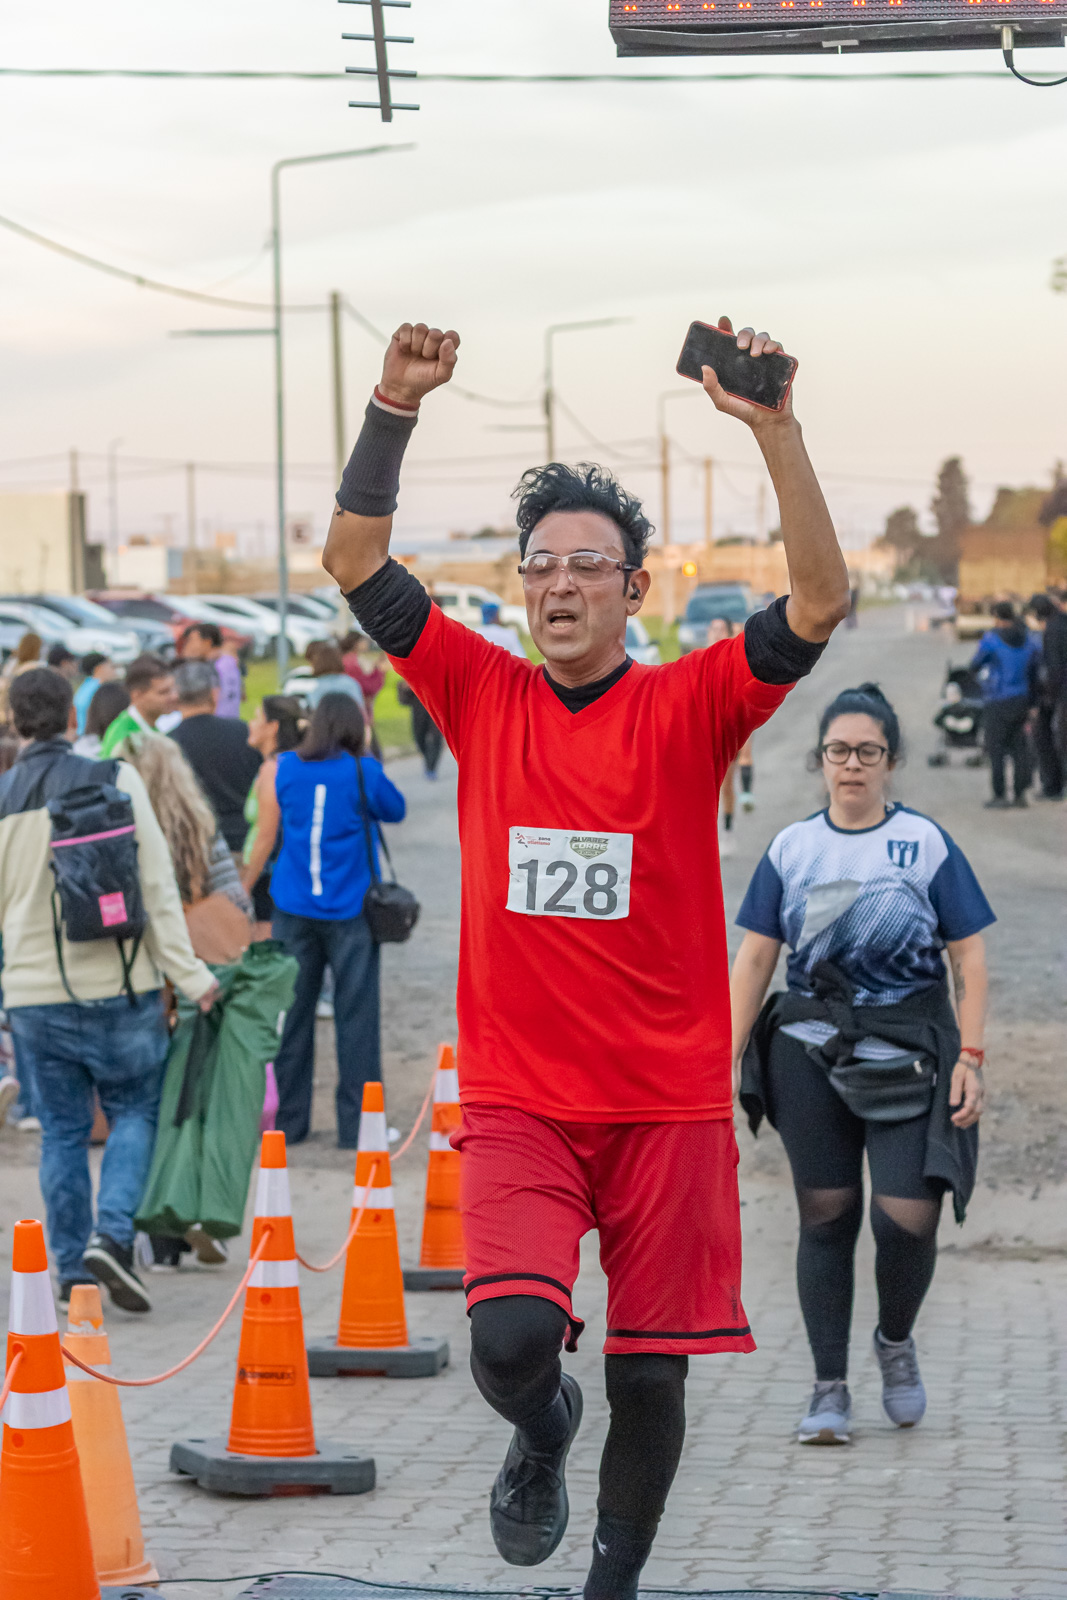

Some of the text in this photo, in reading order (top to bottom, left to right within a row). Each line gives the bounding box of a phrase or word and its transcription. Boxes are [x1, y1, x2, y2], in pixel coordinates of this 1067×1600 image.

[569, 836, 610, 844] ALVAREZ
[572, 842, 608, 850] CORRE
[517, 859, 618, 916] 128
